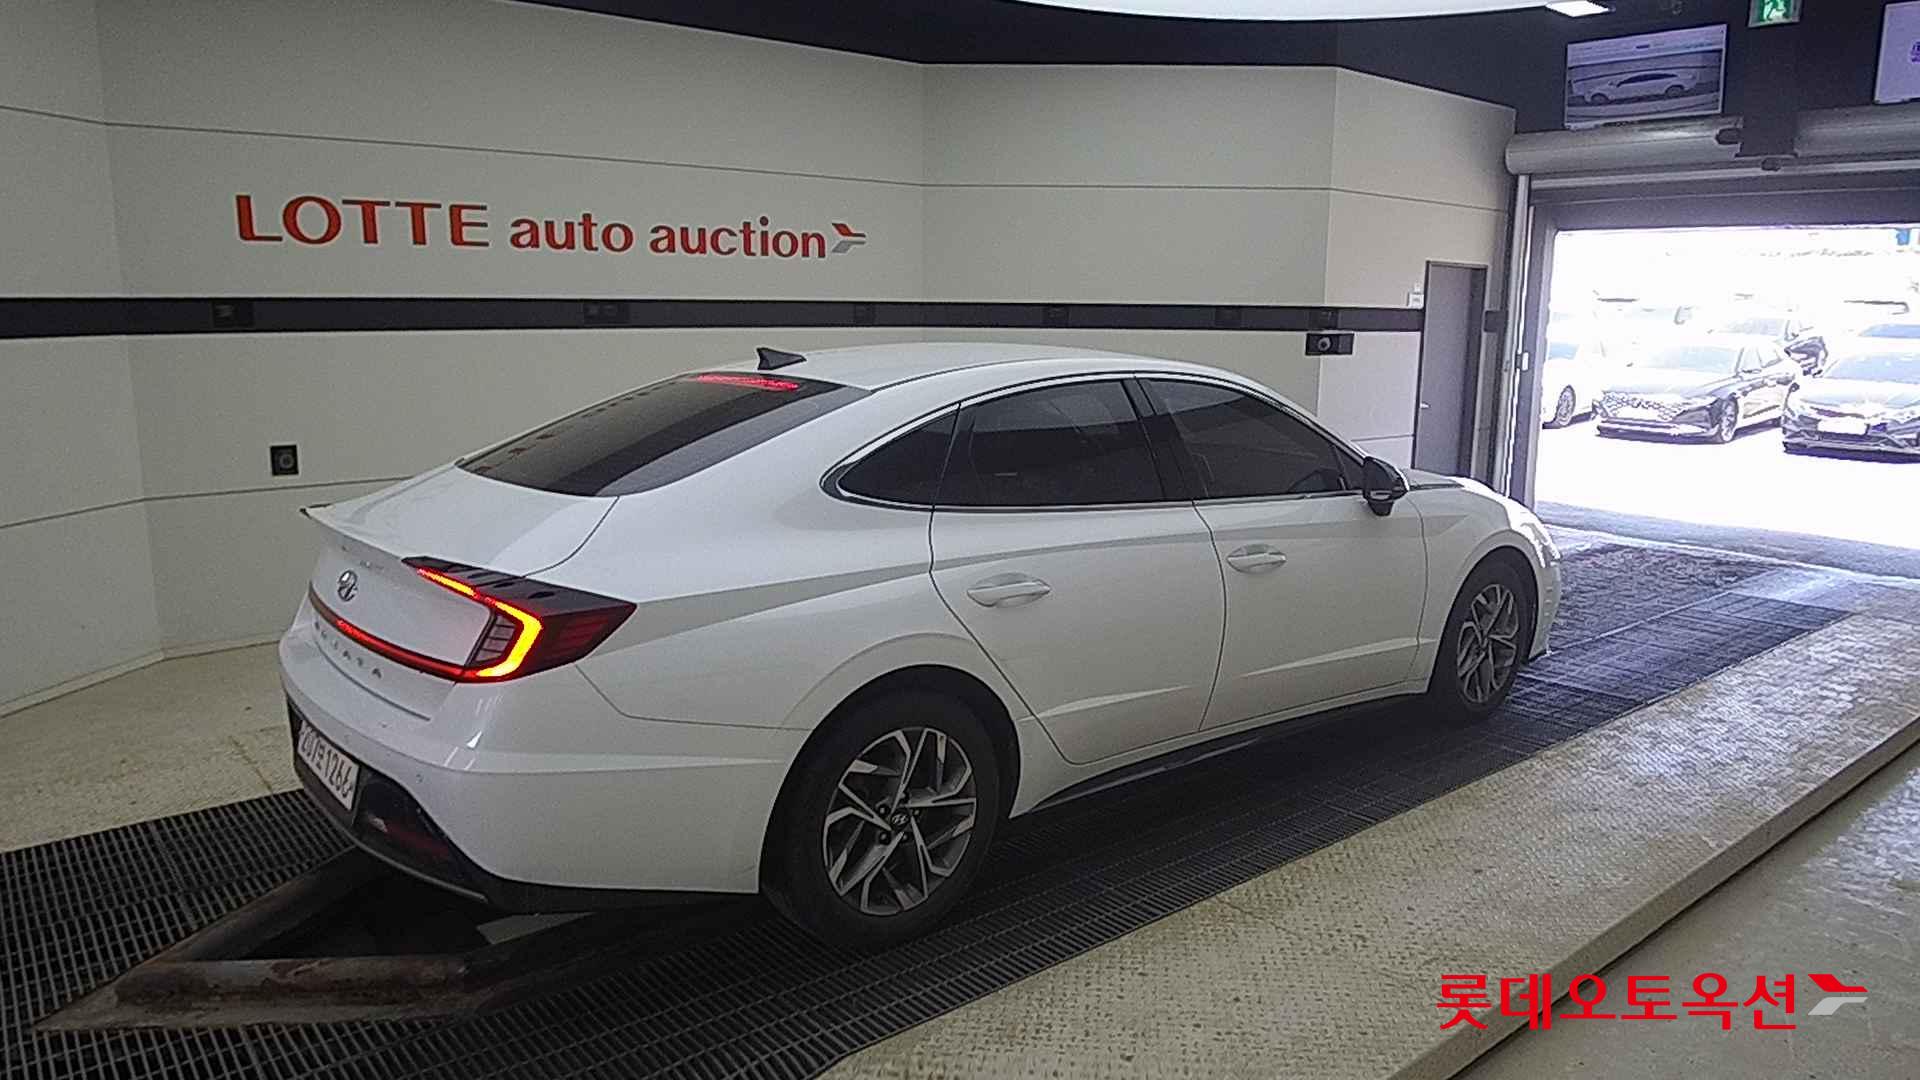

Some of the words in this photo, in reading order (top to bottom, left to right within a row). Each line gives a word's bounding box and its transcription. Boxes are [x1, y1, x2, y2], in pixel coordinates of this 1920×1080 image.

[235, 194, 490, 248] LOTTE
[509, 212, 635, 253] auto
[648, 215, 826, 259] auction
